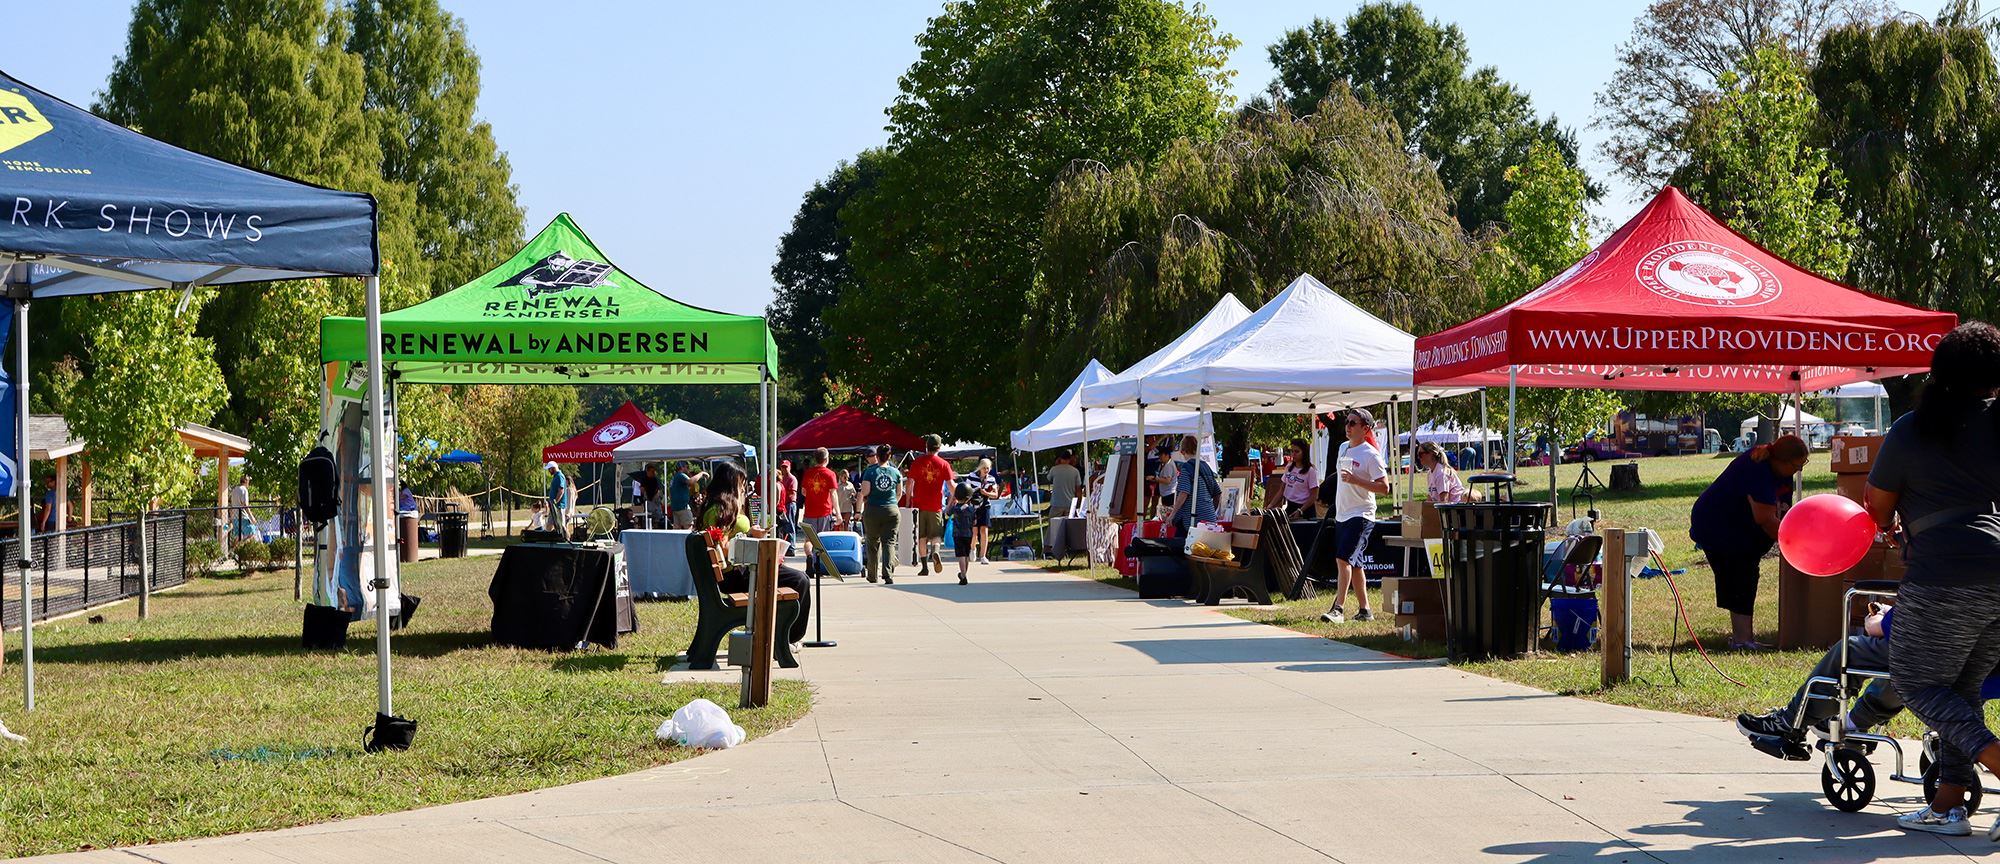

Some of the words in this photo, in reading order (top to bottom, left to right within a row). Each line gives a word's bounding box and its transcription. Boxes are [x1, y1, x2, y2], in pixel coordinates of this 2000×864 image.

[0, 106, 36, 124] R
[7, 165, 92, 175] REMODELING
[97, 203, 263, 243] SHOWS
[1642, 242, 1732, 270] PROVIDENCE
[1643, 275, 1681, 298] UPPER
[1742, 259, 1777, 299] TOWNSHIP
[485, 296, 620, 311] RENEWAL
[500, 309, 620, 319] ANDERSEN
[381, 333, 523, 354] RENEWAL
[528, 333, 551, 354] by
[555, 332, 708, 353] ANDERSEN
[1413, 349, 1430, 372] UPPER
[1430, 341, 1470, 368] PROVIDENCE
[1470, 329, 1508, 360] TOWNSHIP
